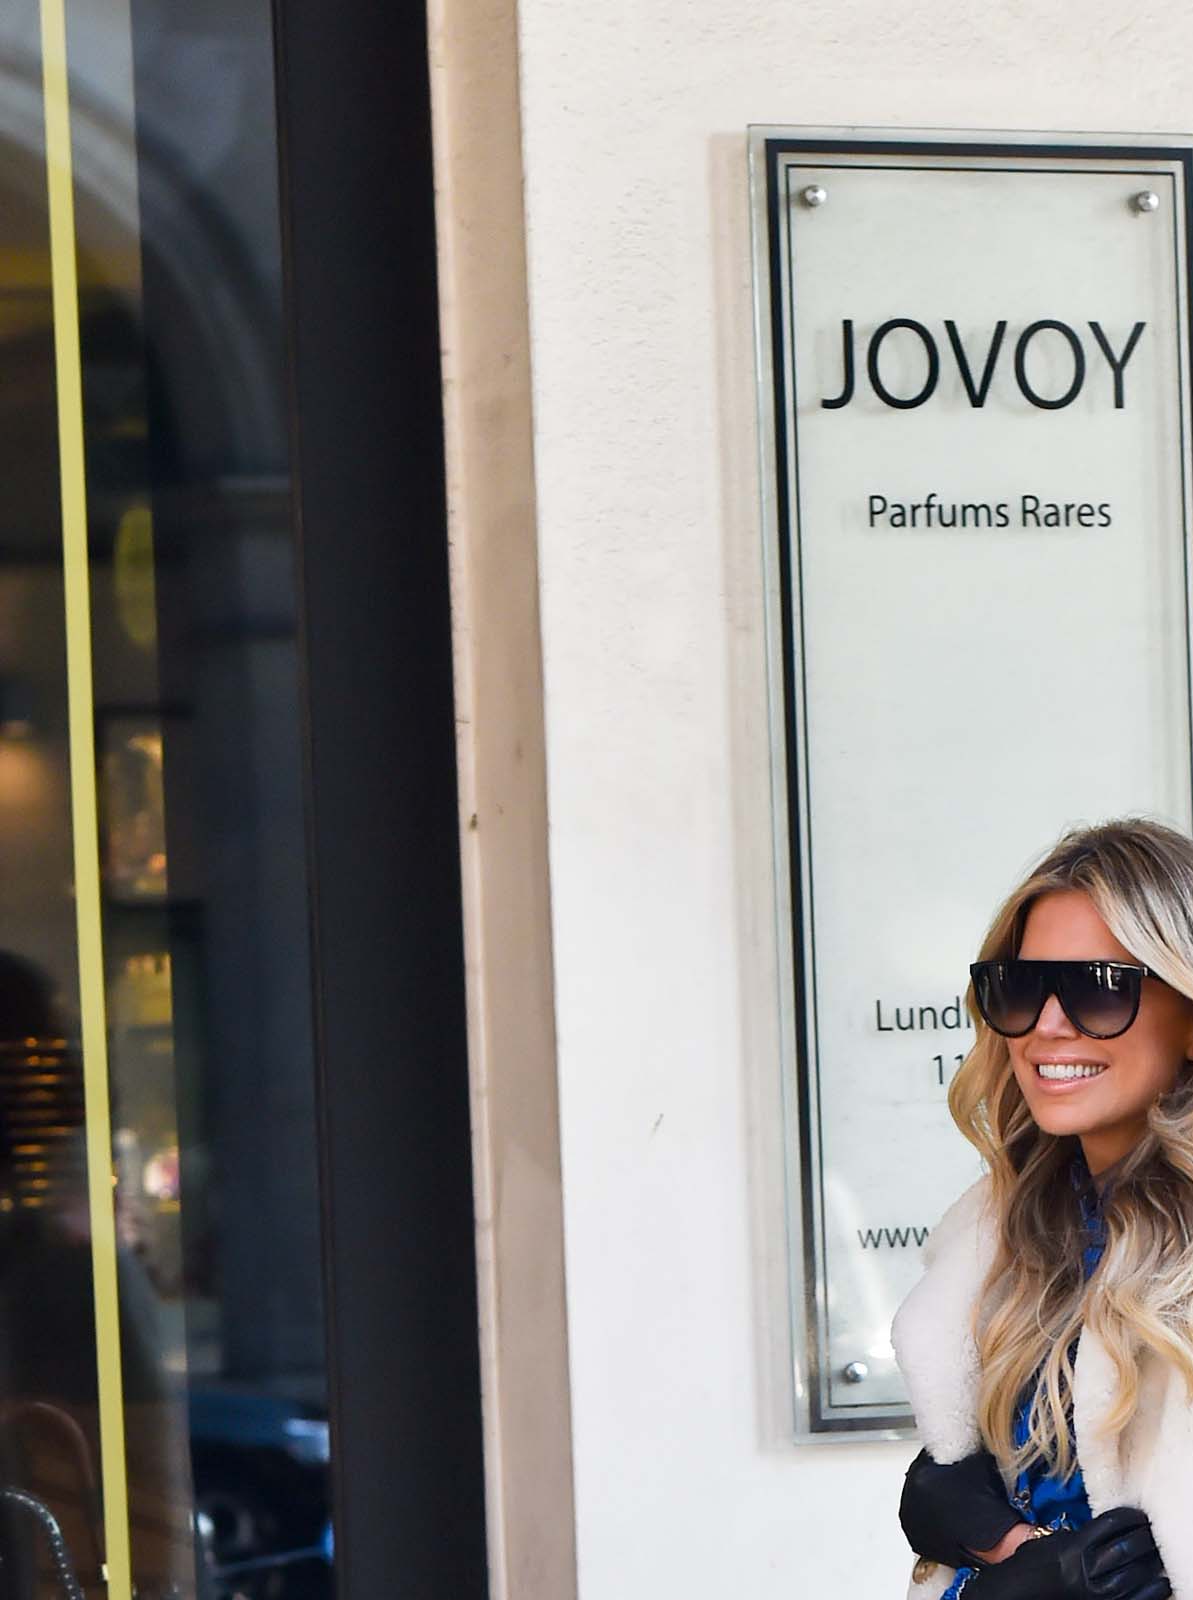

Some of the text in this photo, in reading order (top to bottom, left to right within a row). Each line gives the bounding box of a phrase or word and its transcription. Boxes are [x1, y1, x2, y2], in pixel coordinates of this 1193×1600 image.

[821, 318, 1146, 410] JOVOY
[868, 493, 1111, 528] Parfums Rares
